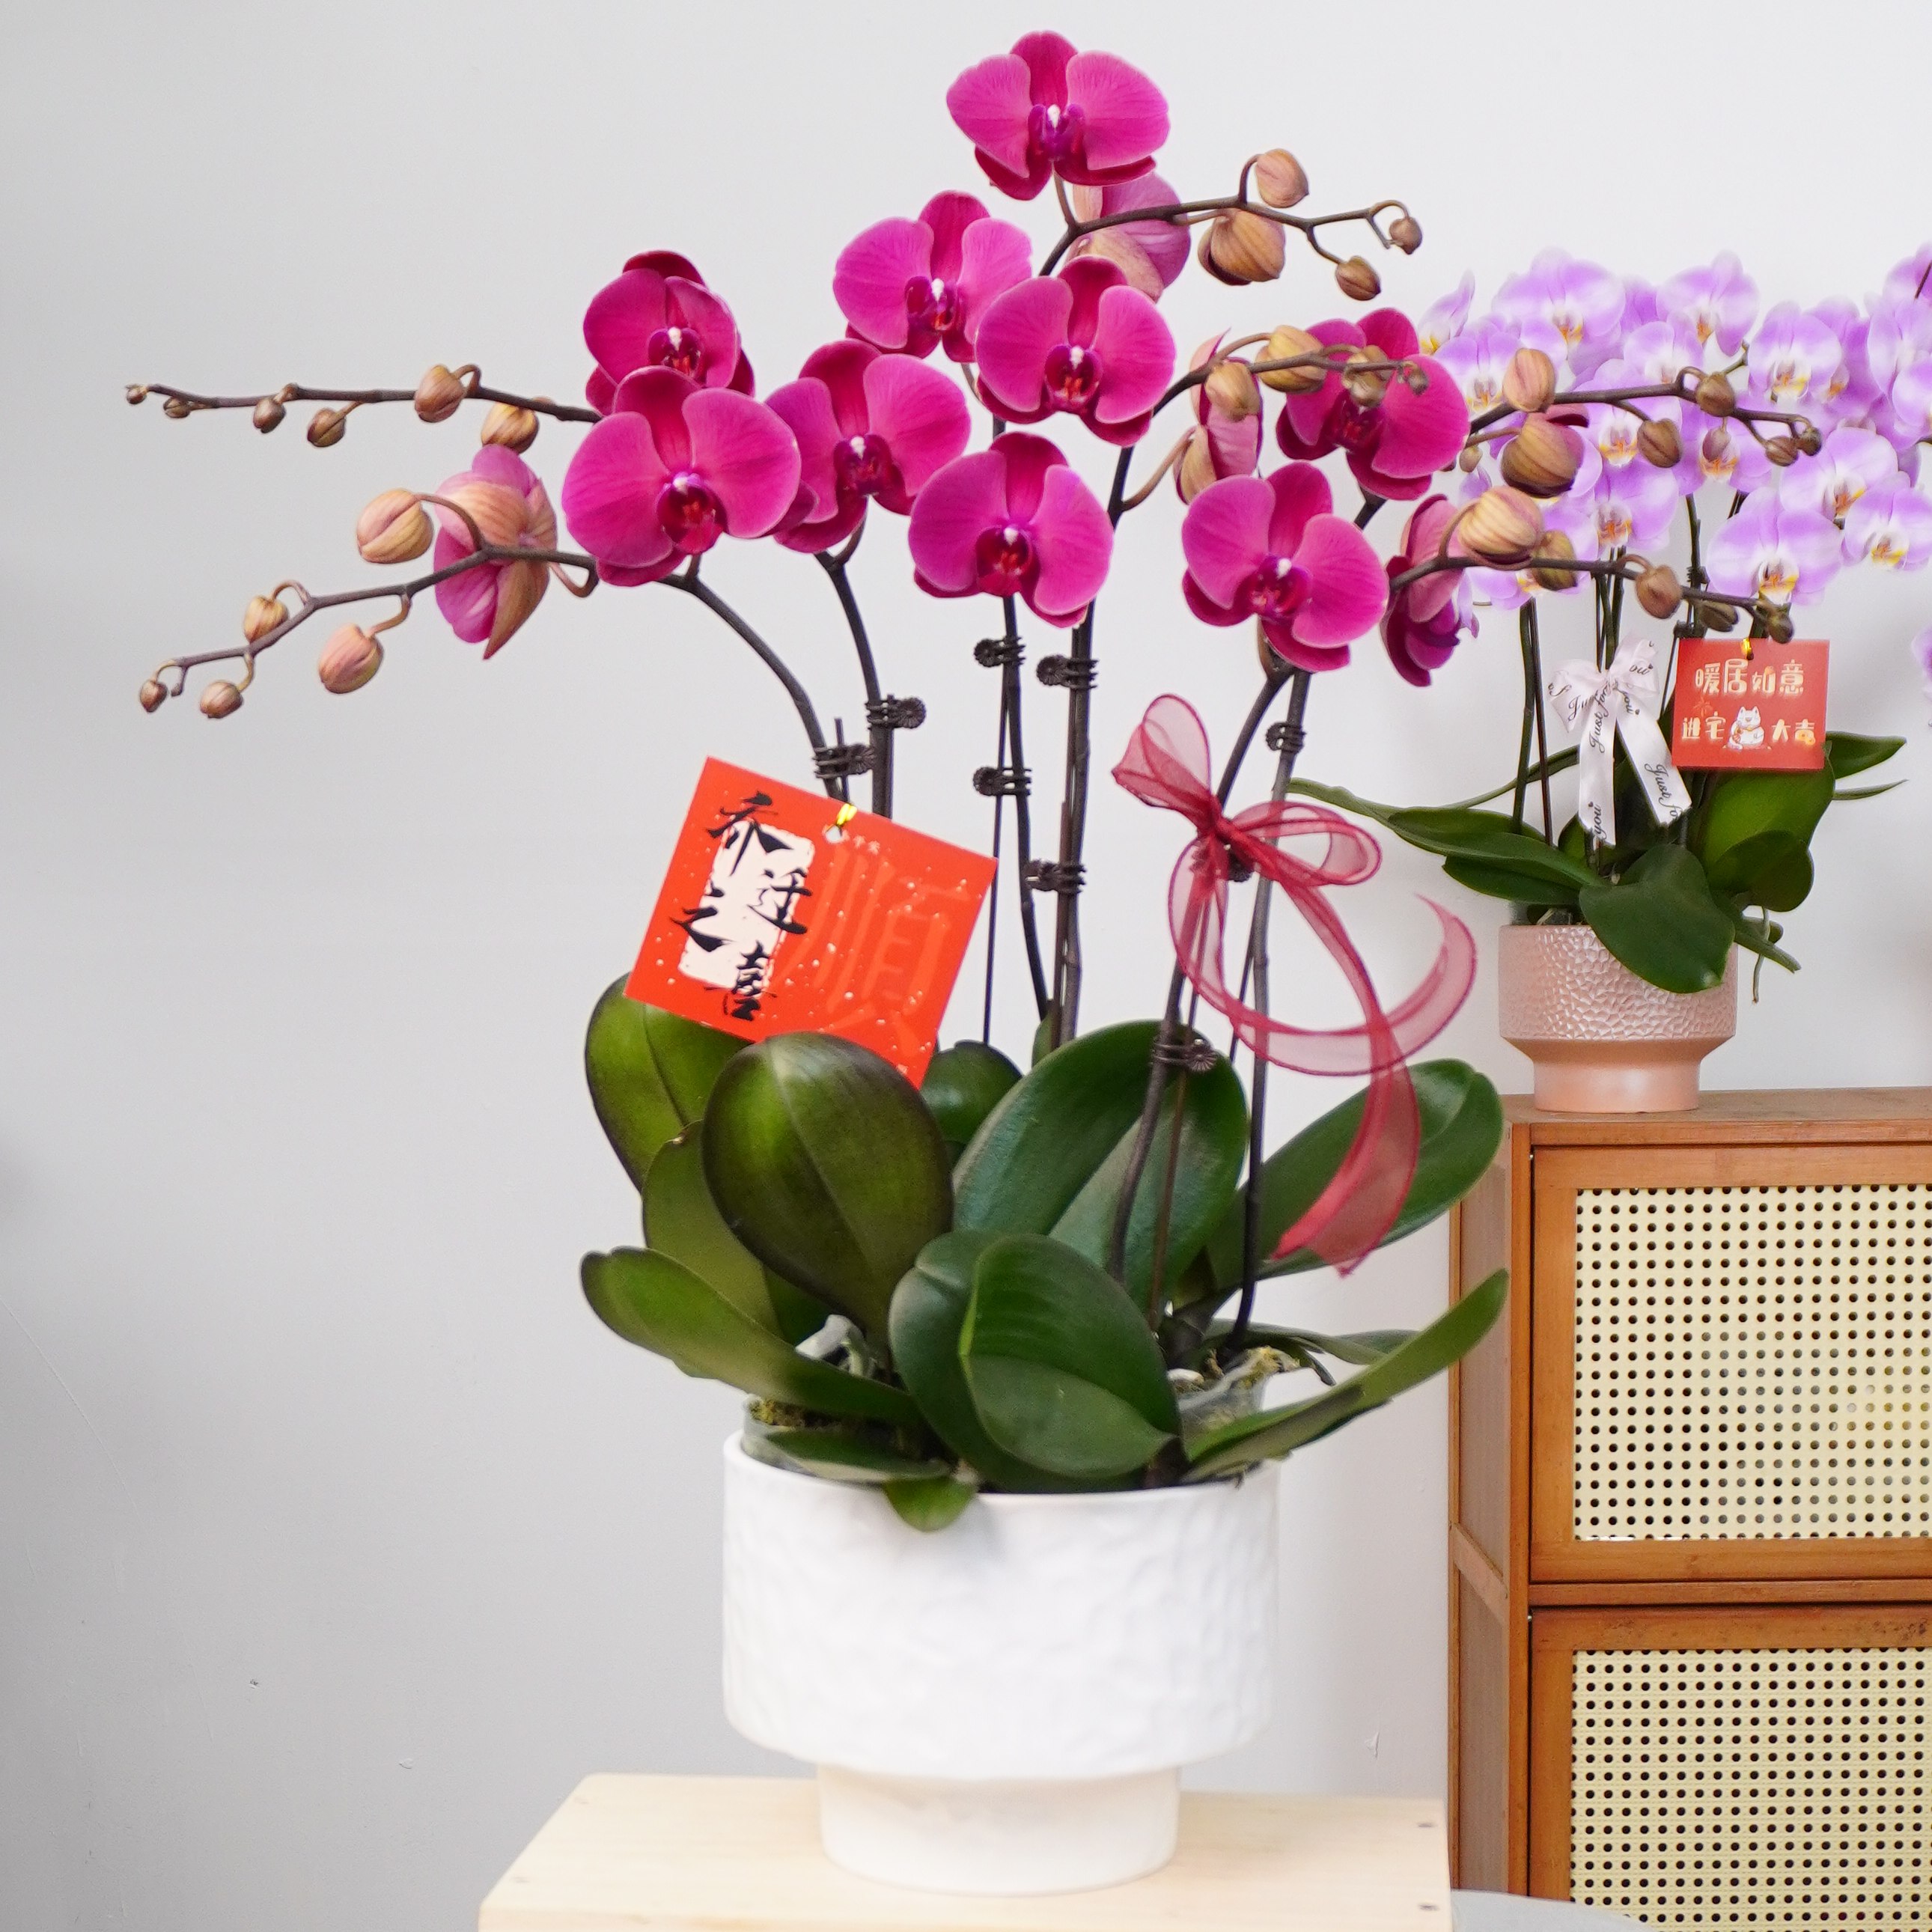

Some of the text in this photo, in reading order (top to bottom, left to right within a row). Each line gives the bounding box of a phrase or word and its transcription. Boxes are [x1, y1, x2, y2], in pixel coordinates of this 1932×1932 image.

[1695, 658, 1805, 695] 暖居如意
[1588, 710, 1606, 754] Just
[1771, 719, 1816, 744] 大吉
[1644, 763, 1683, 817] Just fo
[1593, 803, 1607, 840] you
